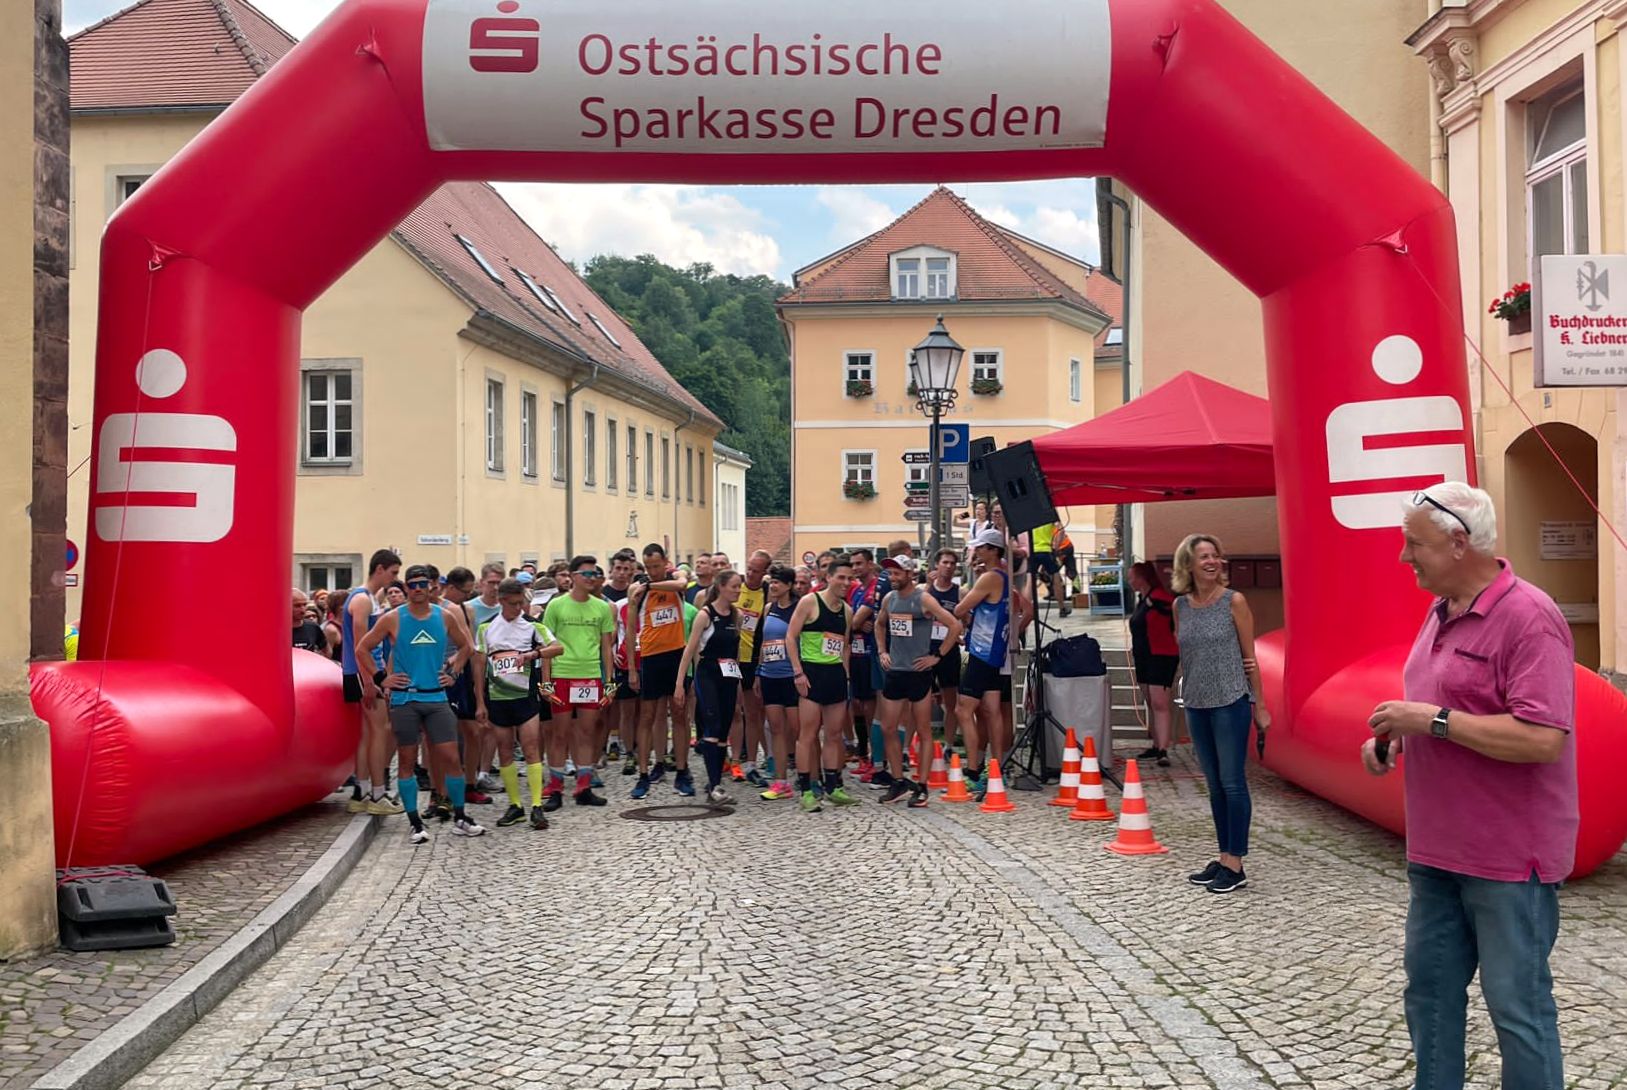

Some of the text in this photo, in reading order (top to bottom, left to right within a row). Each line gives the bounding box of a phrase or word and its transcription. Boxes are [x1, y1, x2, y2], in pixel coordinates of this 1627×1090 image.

[578, 33, 942, 76] Ostsächsische
[580, 93, 1061, 147] Sparkasse Dresden
[1562, 367, 1577, 375] Tel.
[1585, 367, 1600, 375] Fax
[939, 429, 960, 459] P
[655, 608, 673, 621] 447
[891, 619, 907, 631] 525
[578, 687, 591, 699] 29
